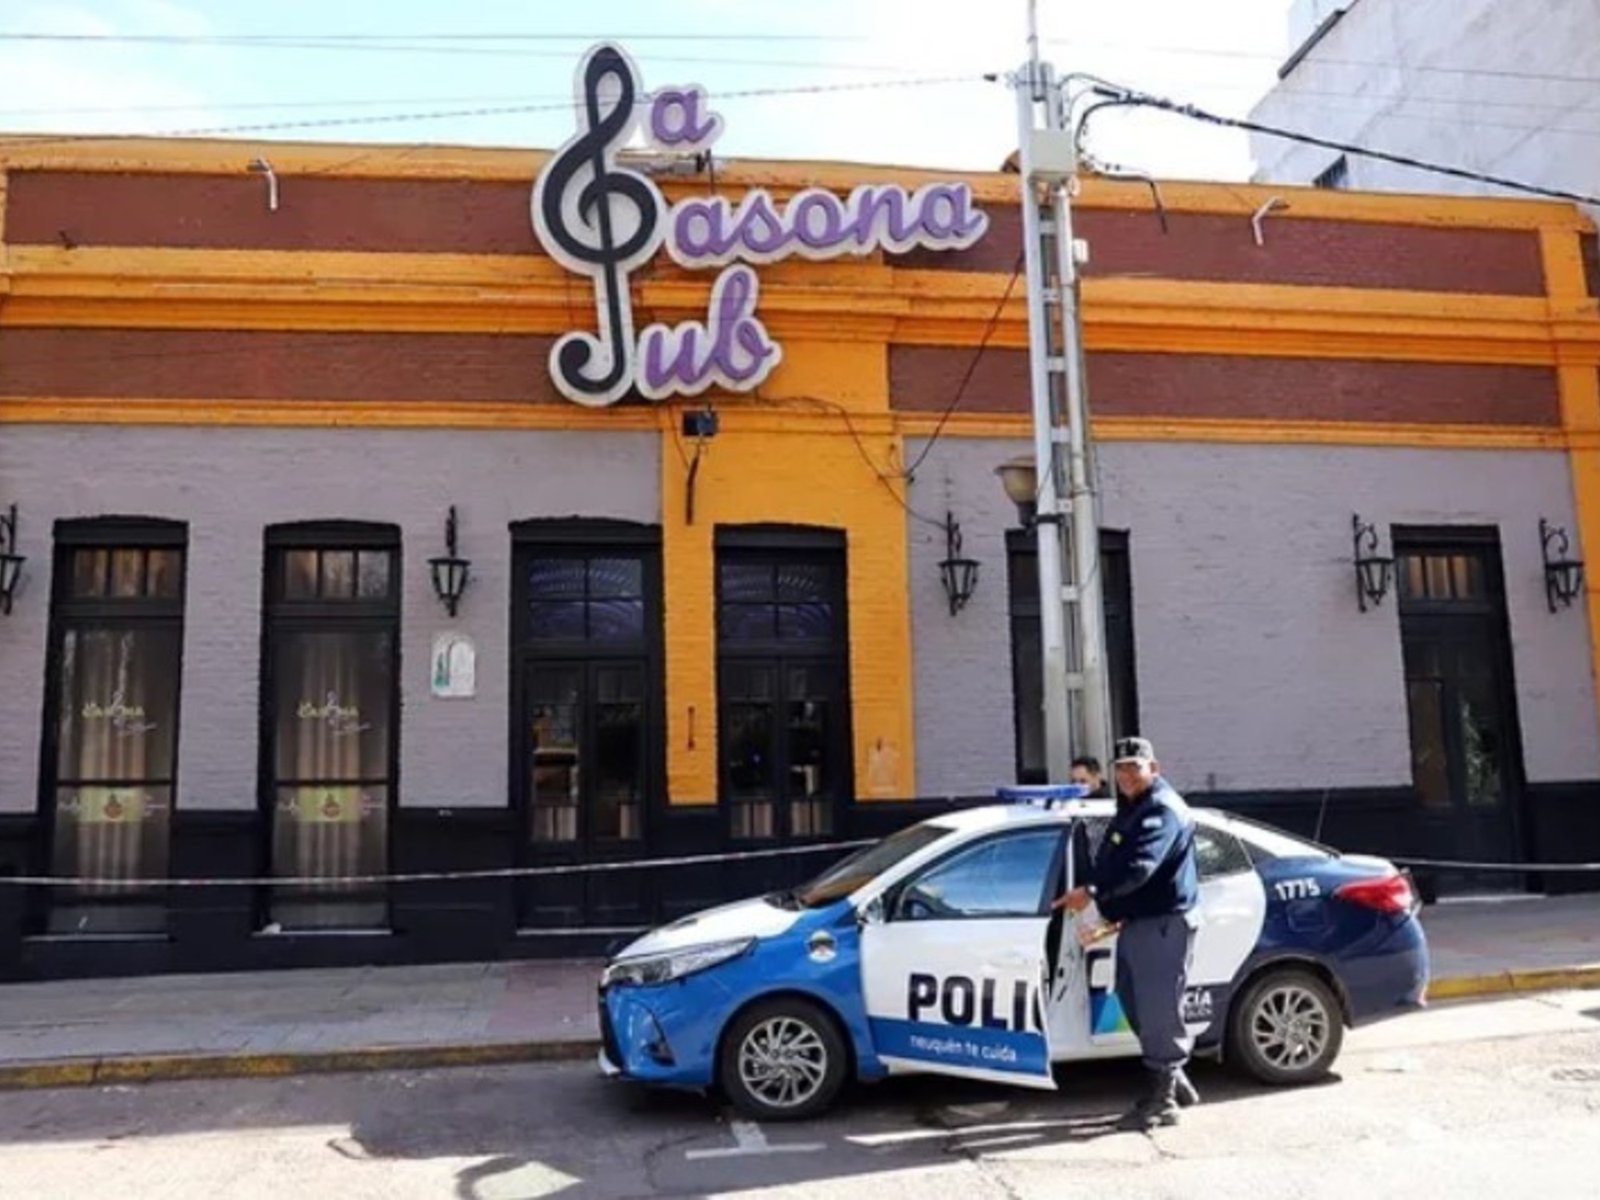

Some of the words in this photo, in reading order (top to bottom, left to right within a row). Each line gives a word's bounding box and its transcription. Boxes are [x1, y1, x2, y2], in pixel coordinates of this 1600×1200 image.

[1275, 877, 1321, 900] 1775
[966, 1042, 979, 1057] te
[981, 1044, 1016, 1063] cuida
